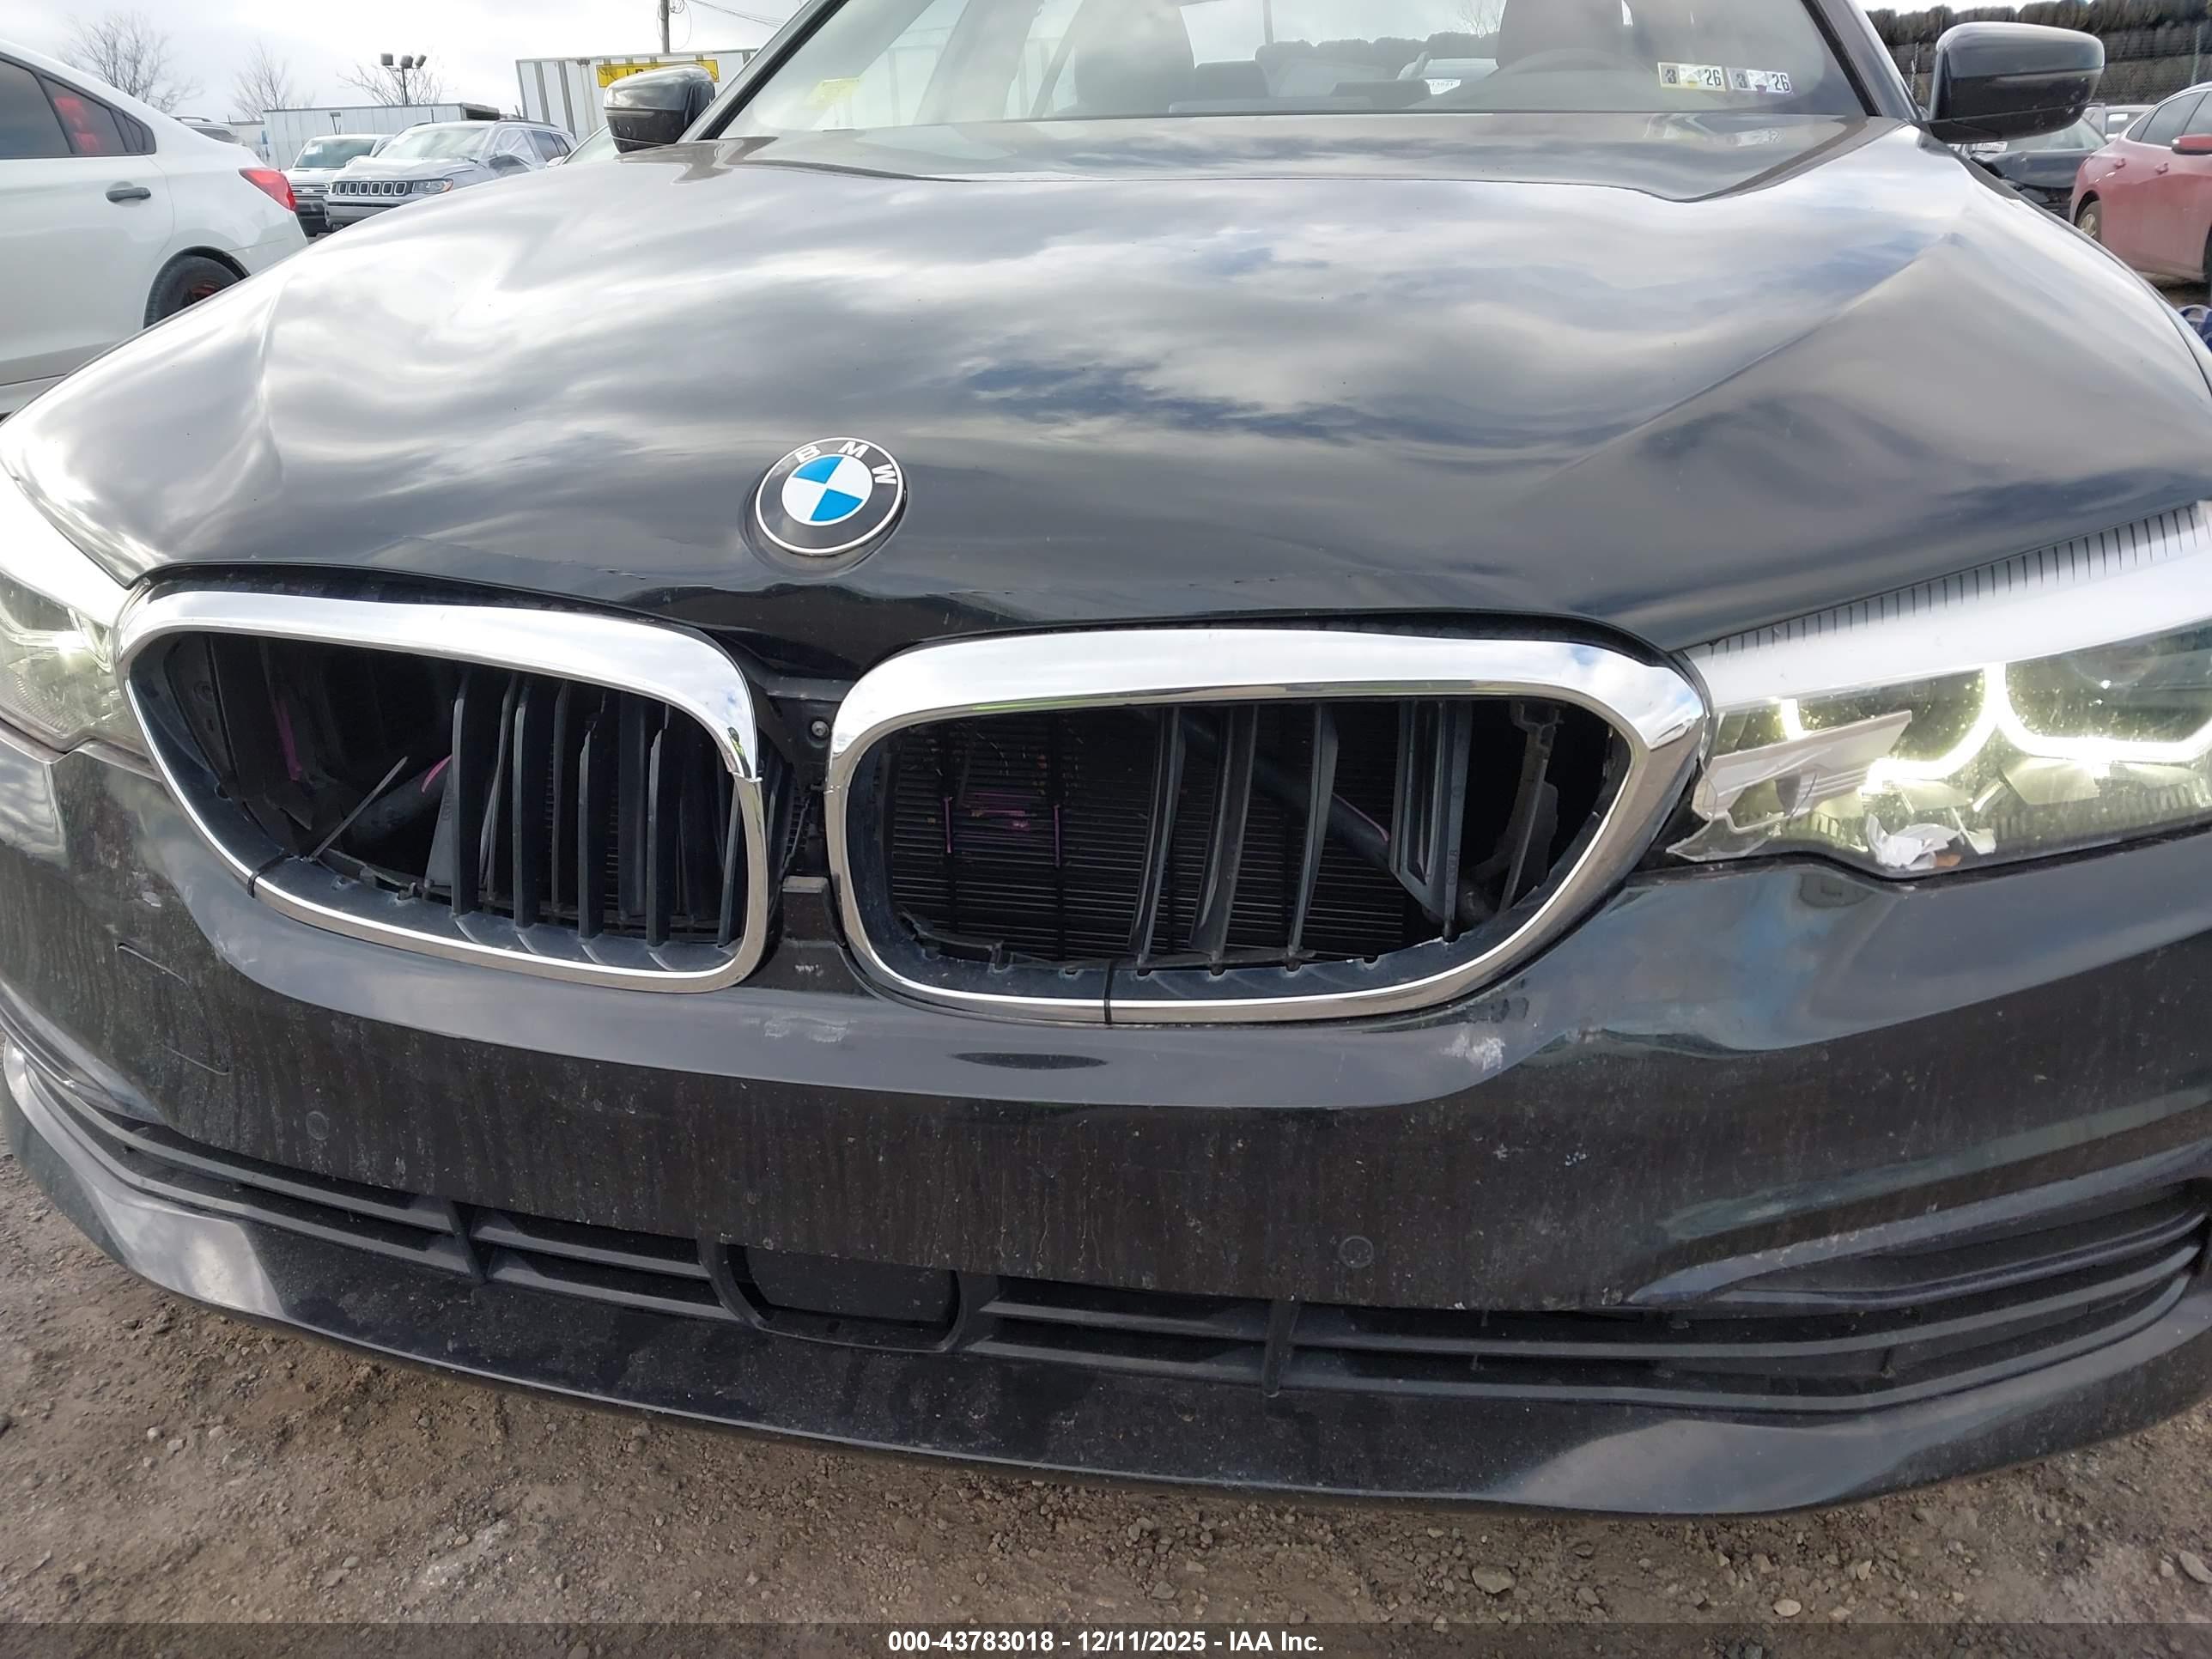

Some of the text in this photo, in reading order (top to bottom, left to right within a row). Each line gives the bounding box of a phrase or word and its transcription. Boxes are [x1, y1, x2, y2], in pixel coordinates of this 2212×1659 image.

[1704, 69, 1722, 86] 26
[1771, 74, 1790, 91] 26
[794, 441, 897, 485] BMW
